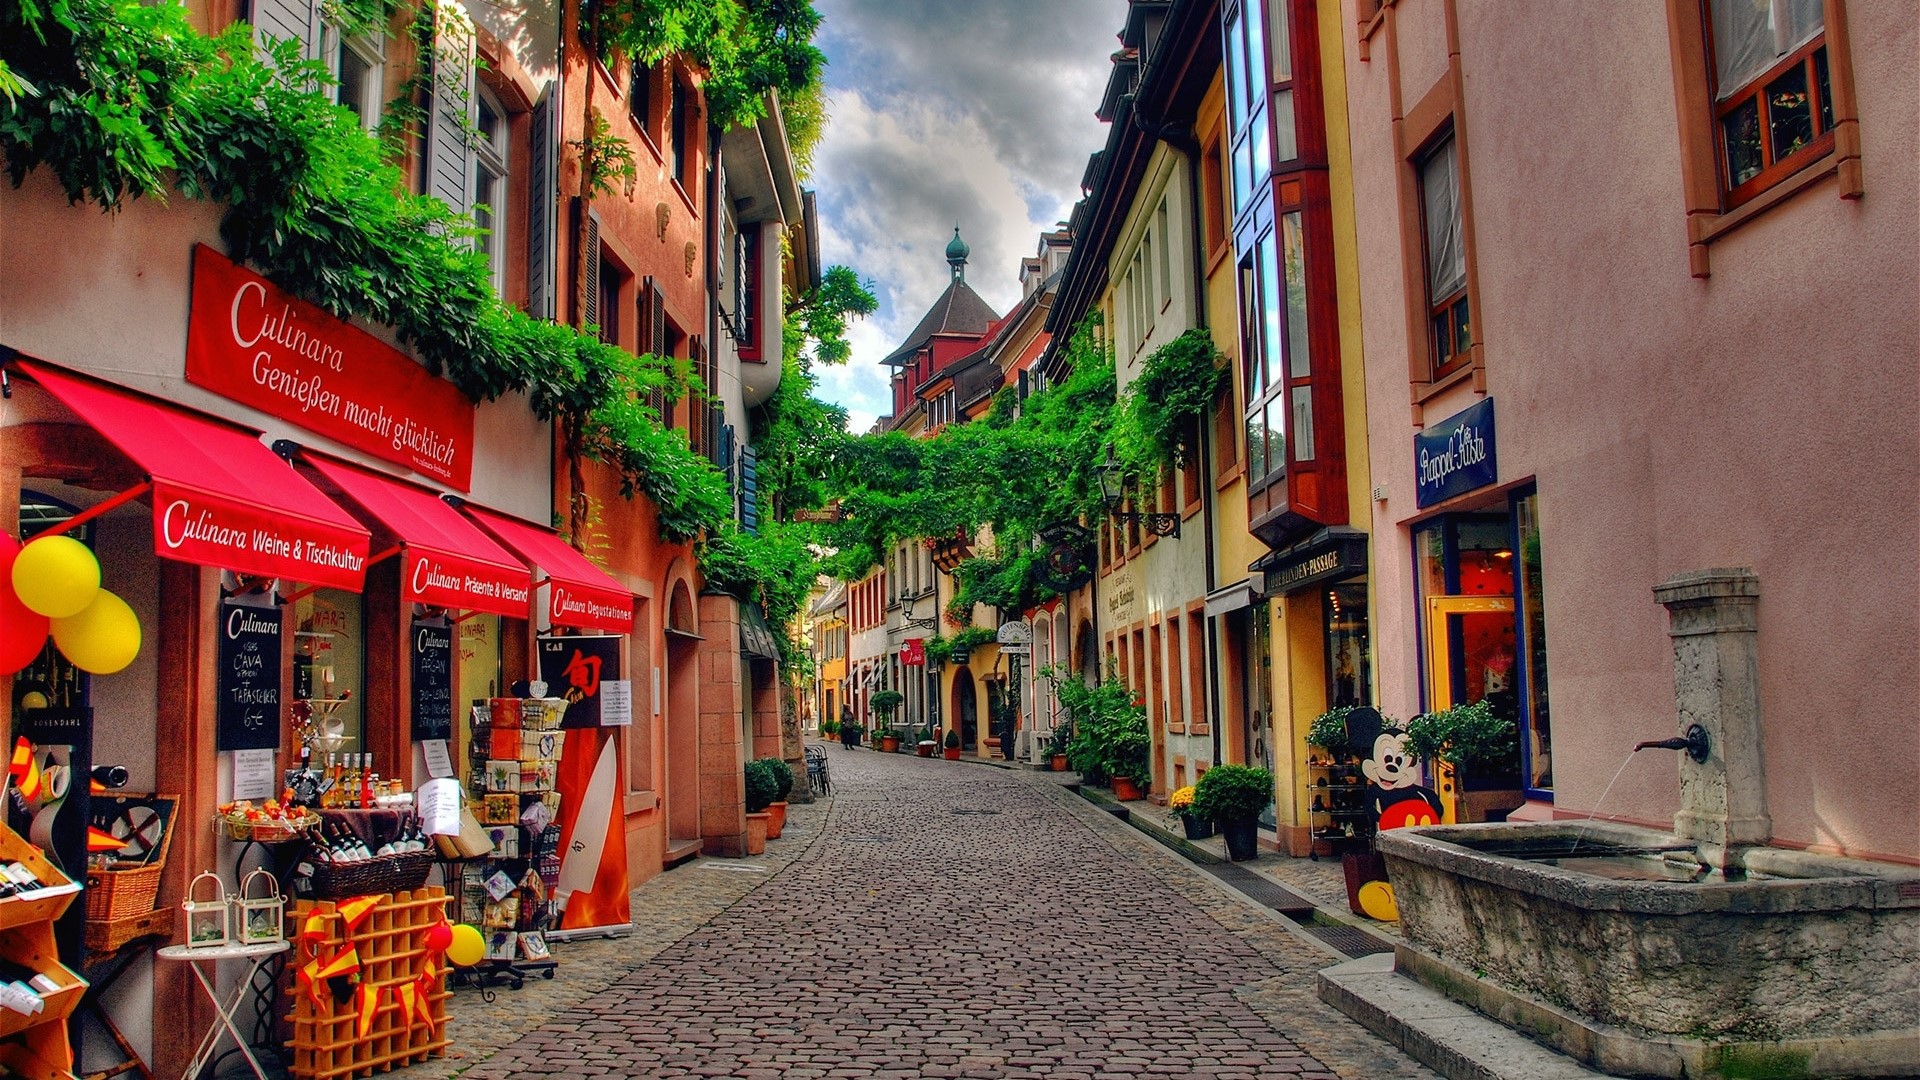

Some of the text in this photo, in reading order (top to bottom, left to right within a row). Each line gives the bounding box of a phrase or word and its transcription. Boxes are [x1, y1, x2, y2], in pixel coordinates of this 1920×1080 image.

[231, 281, 343, 372] Culinara
[253, 351, 455, 466] Genießen macht glücklich
[163, 500, 364, 572] Culinara Weine & Tischkultur
[412, 557, 528, 603] Culinara Präsente & Versand
[554, 588, 632, 620] Culinara Degustationen
[227, 608, 278, 640] Culinara
[418, 628, 449, 653] Culinara
[546, 642, 563, 651] KAI
[233, 652, 263, 670] CAVA
[34, 718, 80, 727] ROSENDAHL
